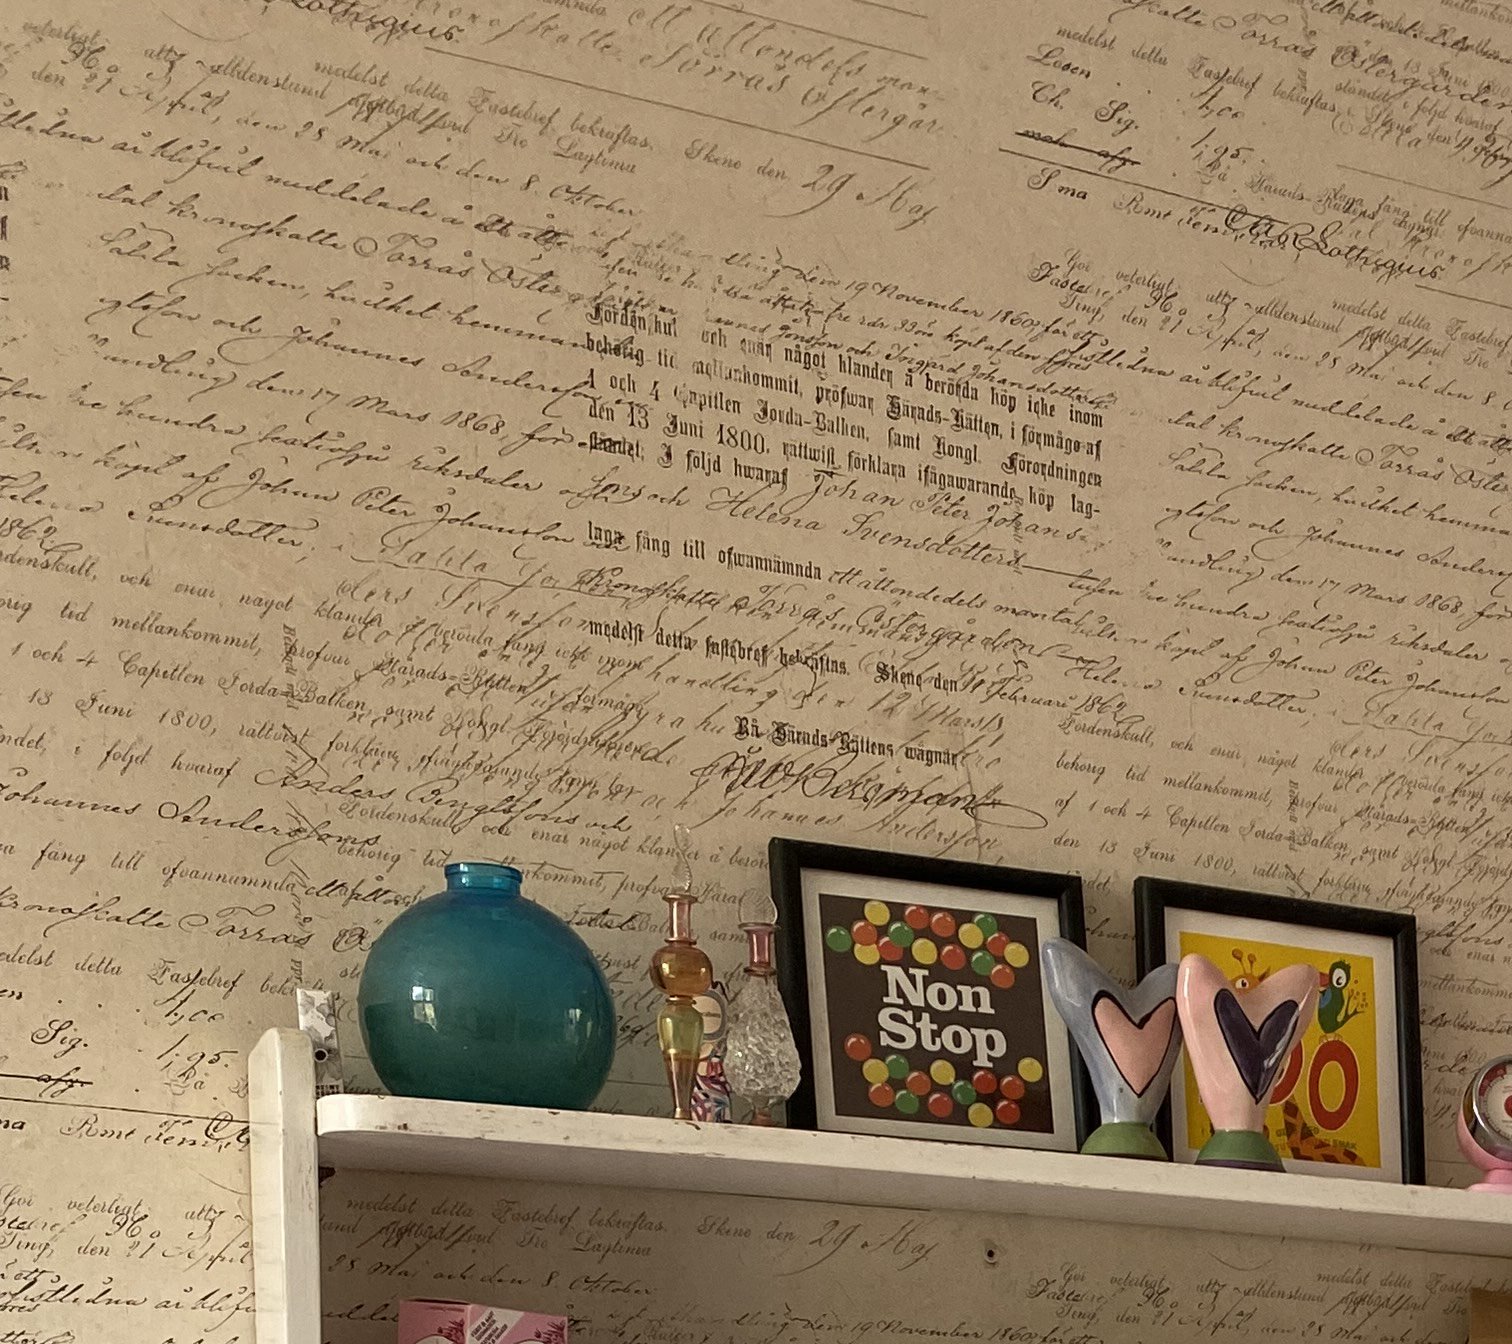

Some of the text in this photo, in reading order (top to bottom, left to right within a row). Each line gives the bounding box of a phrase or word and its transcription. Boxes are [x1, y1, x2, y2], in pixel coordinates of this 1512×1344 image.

[684, 540, 705, 560] till
[881, 964, 995, 1014] Non
[878, 1007, 1007, 1068] Stop
